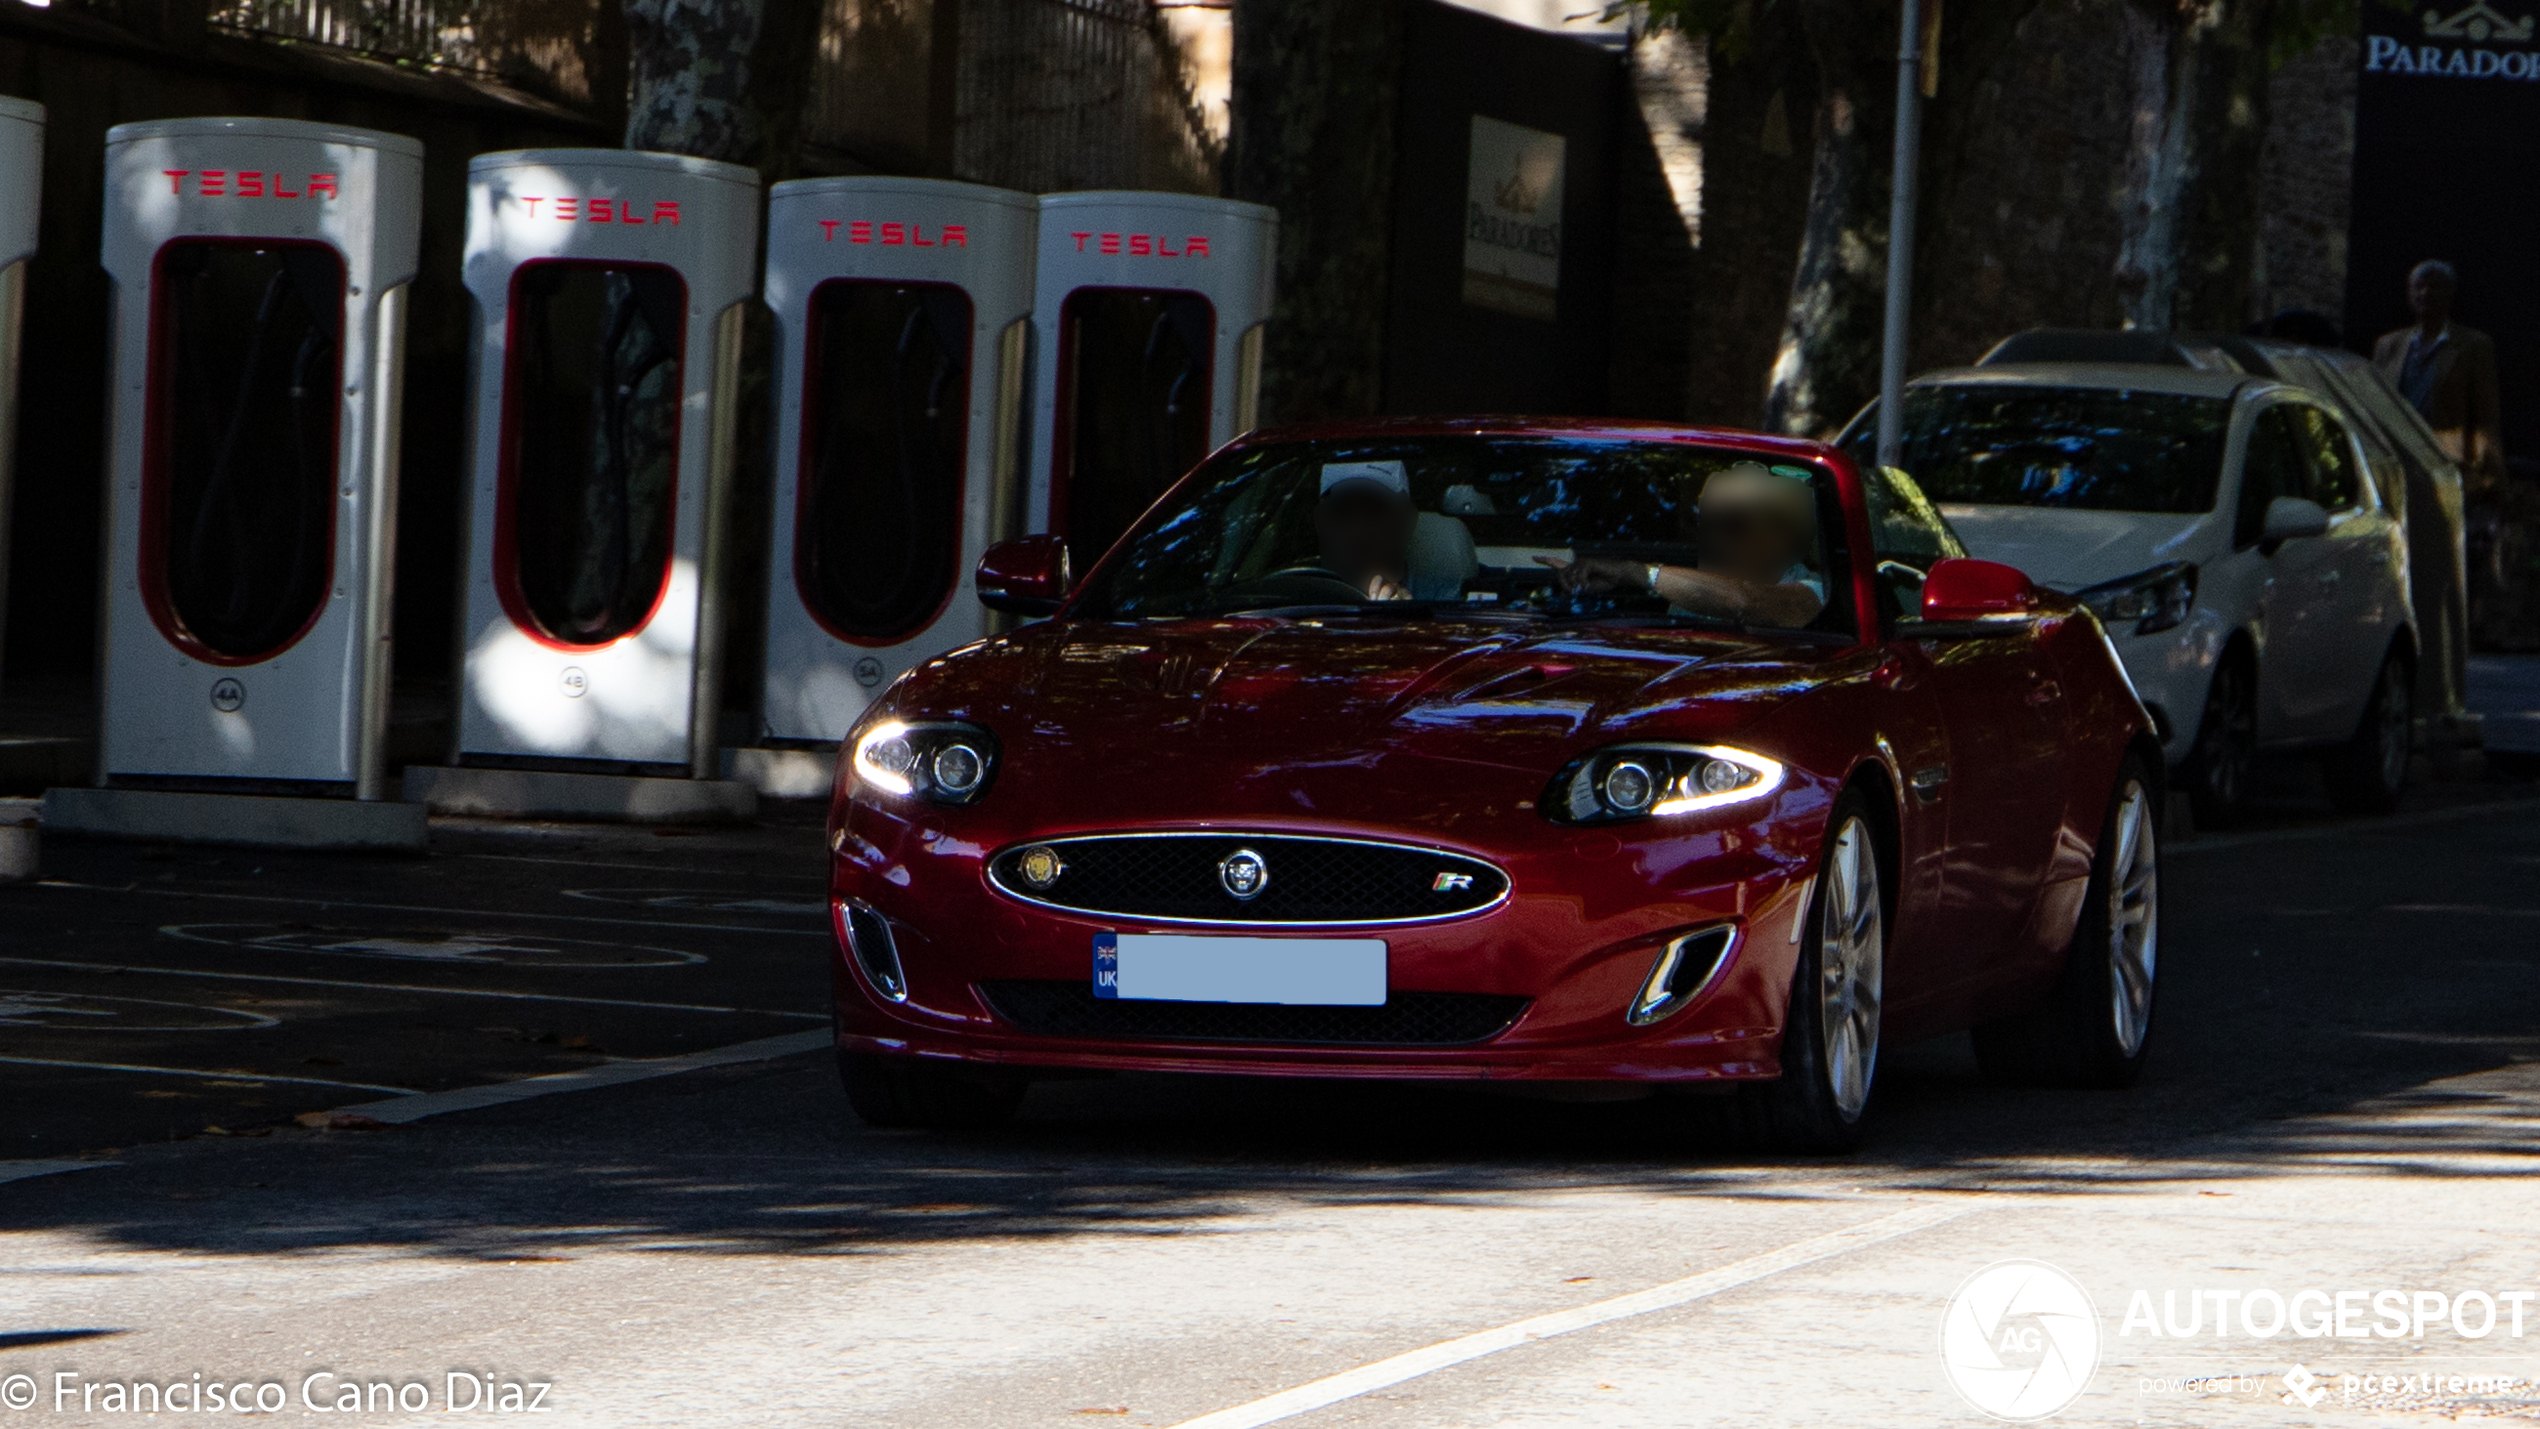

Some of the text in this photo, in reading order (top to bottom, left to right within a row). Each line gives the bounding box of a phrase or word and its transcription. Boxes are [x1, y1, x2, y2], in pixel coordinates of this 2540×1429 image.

[163, 169, 338, 200] TESLA
[522, 197, 681, 226] TESLA
[820, 220, 967, 247] TESLA
[1072, 232, 1210, 258] TESLA
[1098, 970, 1117, 987] UK
